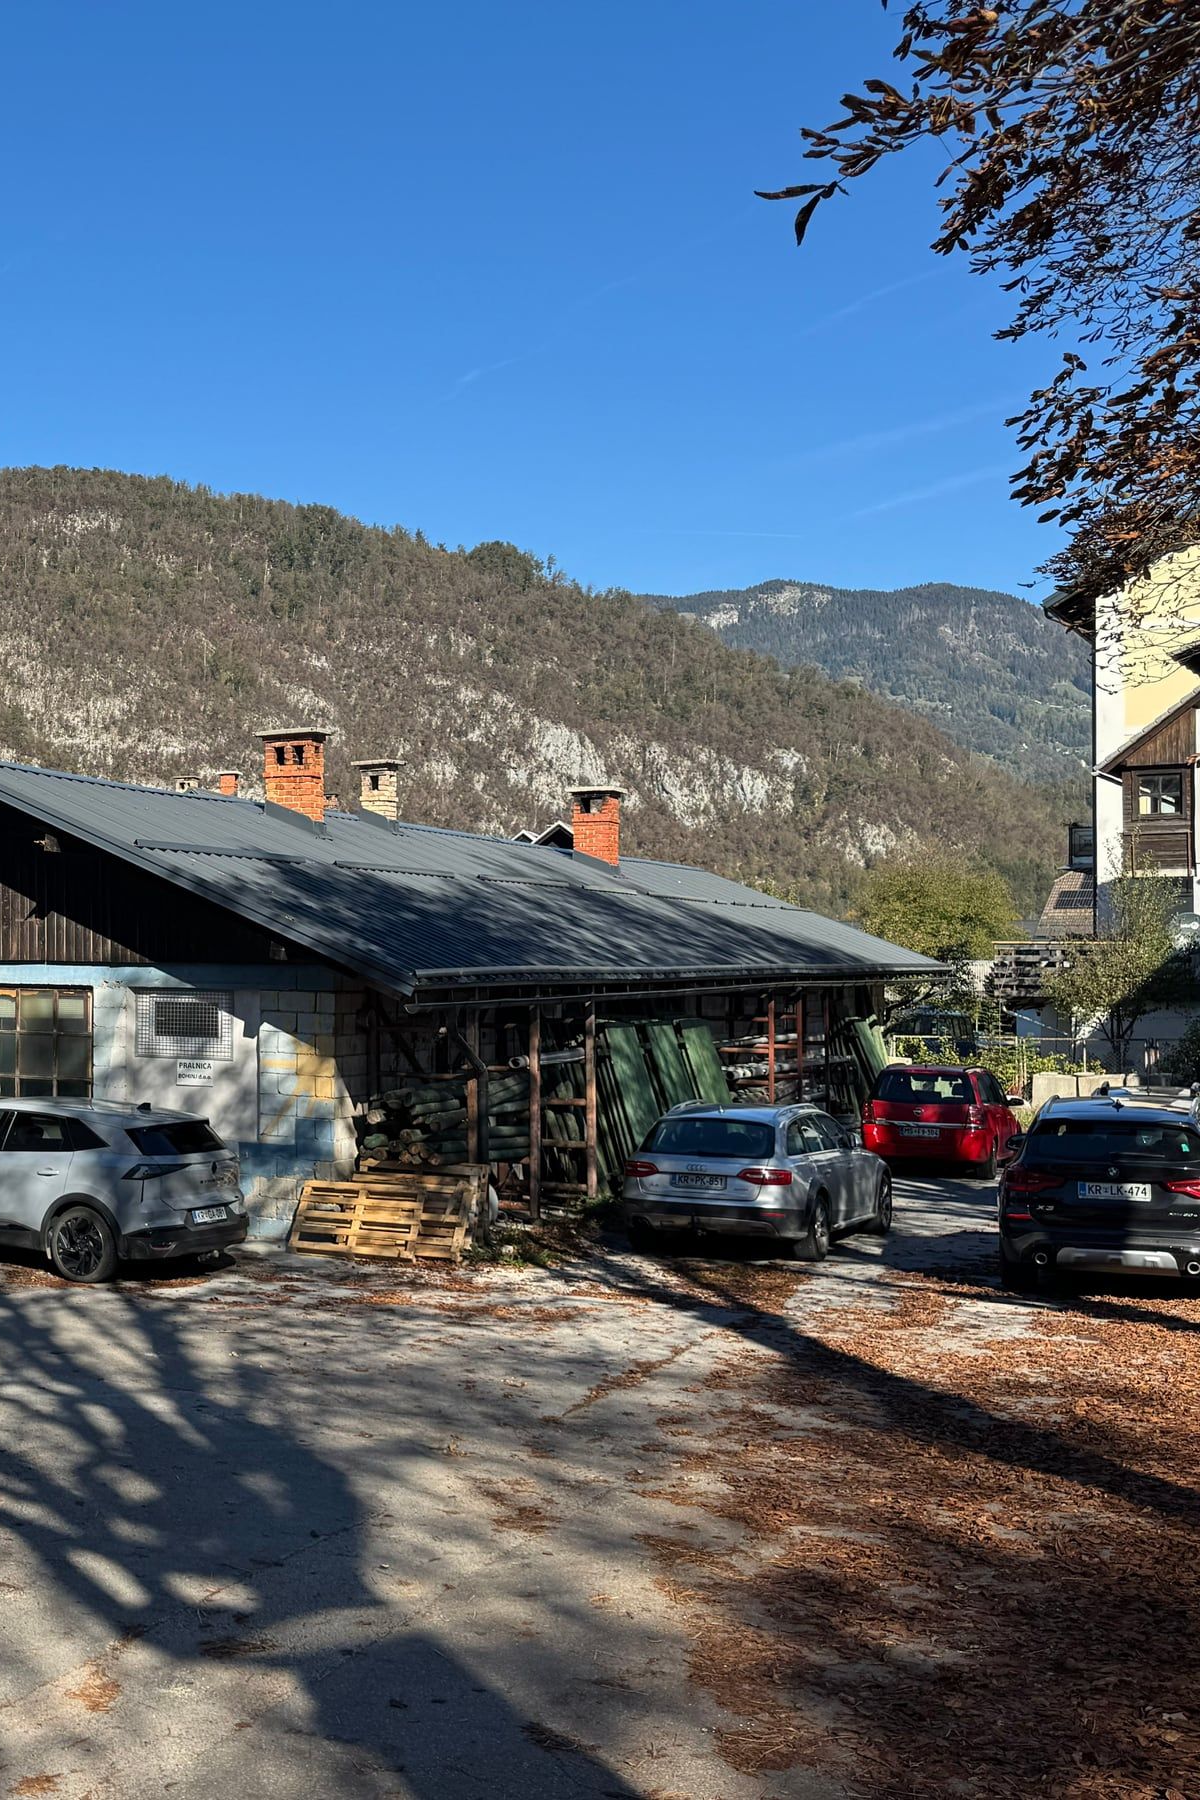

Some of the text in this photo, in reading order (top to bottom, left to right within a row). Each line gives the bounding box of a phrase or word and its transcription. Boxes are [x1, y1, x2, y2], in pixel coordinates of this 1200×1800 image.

[178, 1062, 212, 1070] PRALNICA
[677, 1175, 689, 1184] KR
[1087, 1184, 1102, 1195] KR
[1110, 1184, 1147, 1197] LK-474
